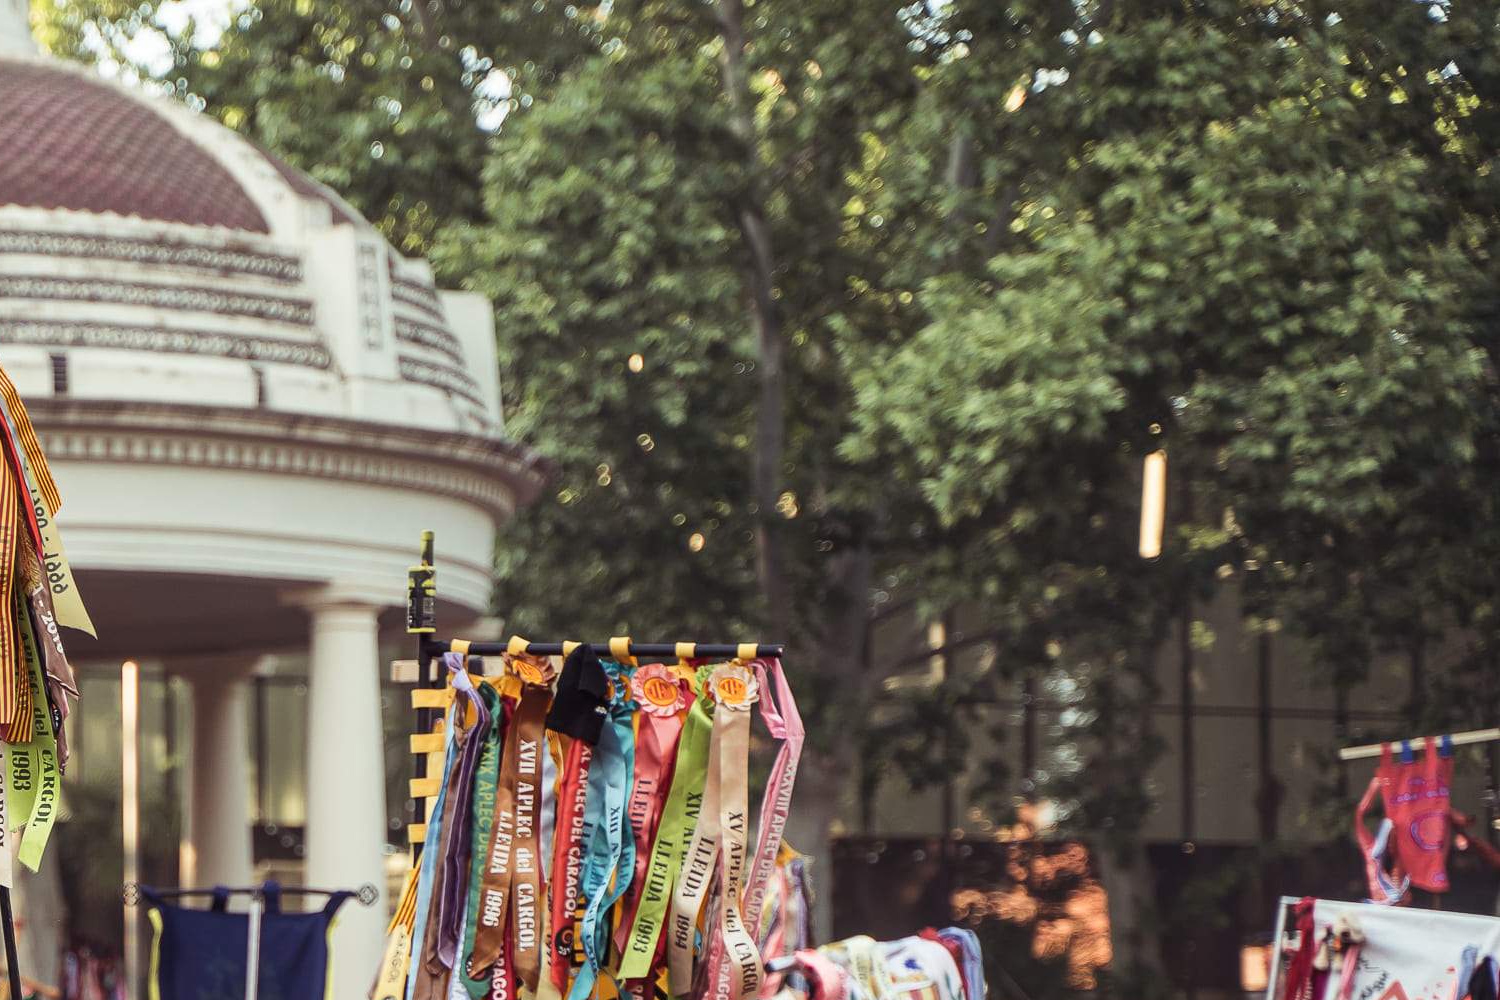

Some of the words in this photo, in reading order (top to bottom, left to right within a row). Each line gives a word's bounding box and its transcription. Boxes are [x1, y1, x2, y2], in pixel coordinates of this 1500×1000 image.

[34, 706, 49, 736] del
[11, 751, 32, 791] 1993
[518, 739, 537, 775] XVII
[32, 749, 54, 828] CARGOL
[478, 781, 498, 830] APLEC
[515, 781, 535, 839] APLEC
[572, 767, 590, 813] APLEC
[490, 810, 513, 874] LLEIDA
[570, 816, 585, 845] DEL
[728, 811, 744, 836] XV
[515, 847, 535, 874] del
[646, 838, 673, 903] LLEIDA
[682, 836, 715, 897] LLEIDA
[726, 841, 744, 899] APLEC
[564, 846, 581, 919] CARAGOL
[482, 888, 504, 928] 1996
[516, 882, 536, 952] CARGOL
[725, 908, 740, 934] del
[632, 917, 655, 954] 1993
[674, 914, 690, 951] 1994
